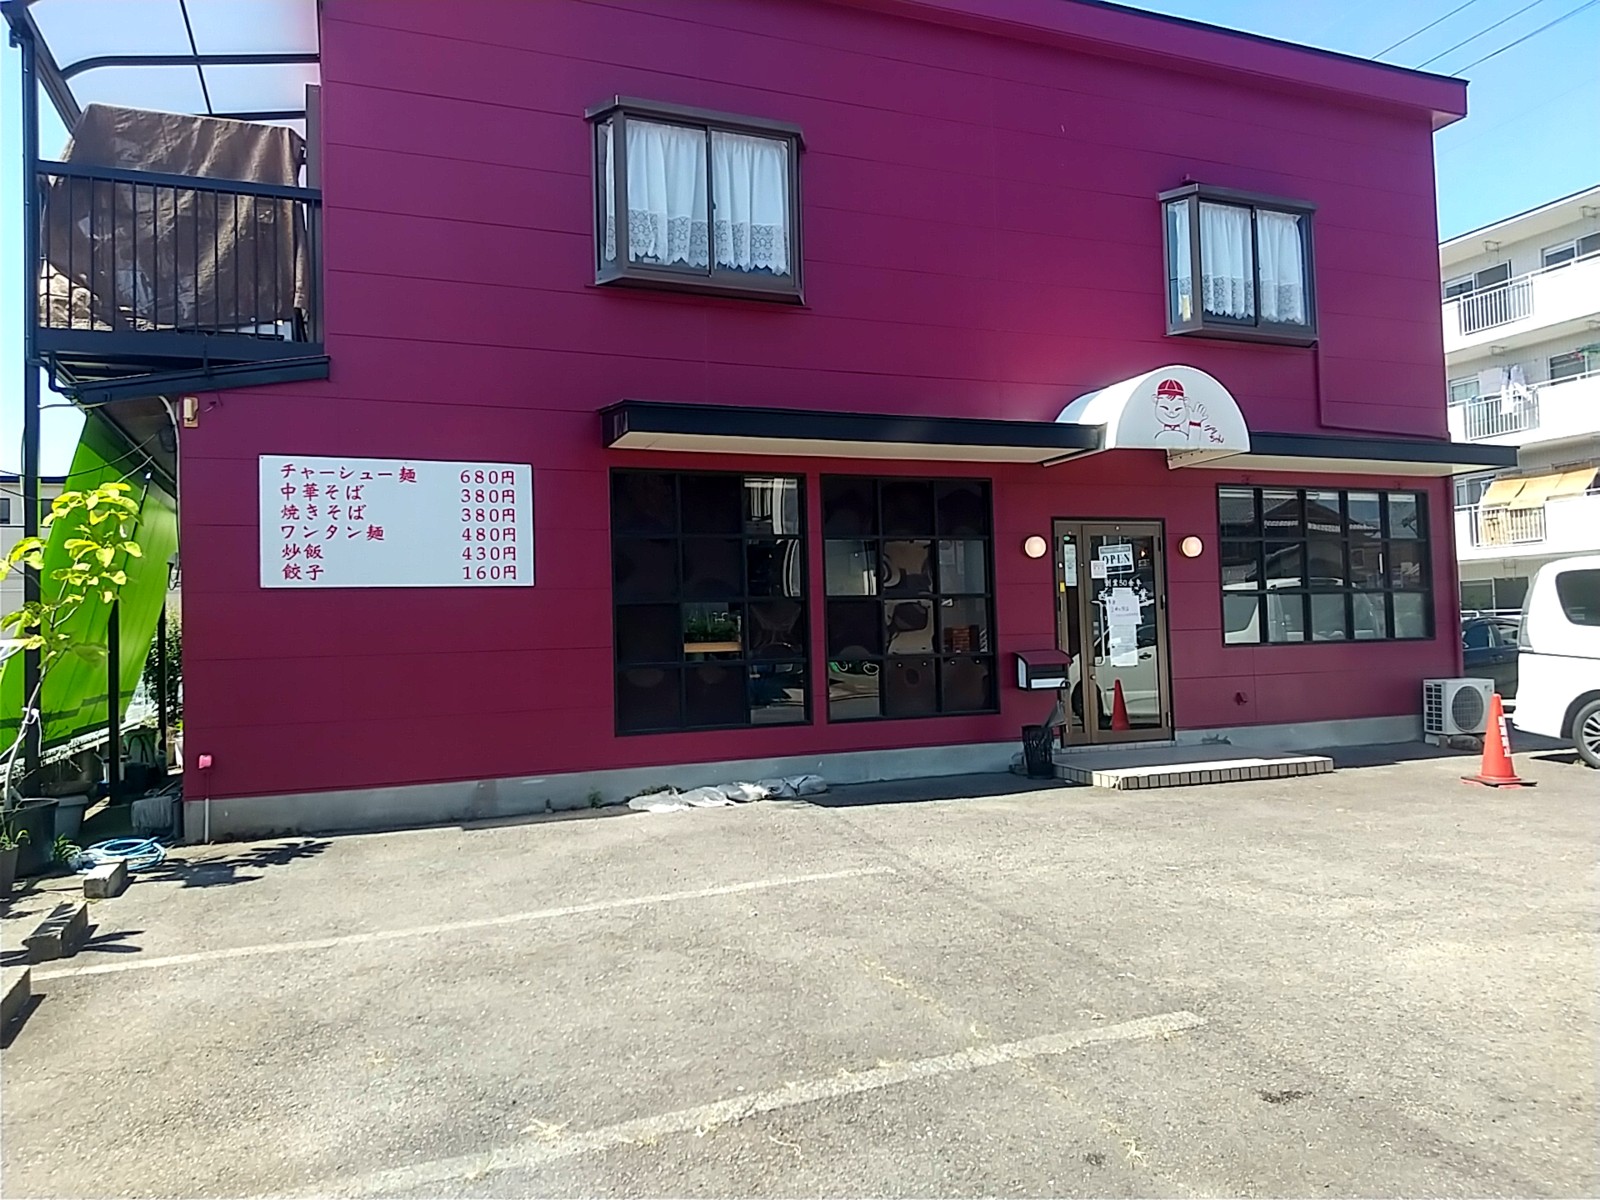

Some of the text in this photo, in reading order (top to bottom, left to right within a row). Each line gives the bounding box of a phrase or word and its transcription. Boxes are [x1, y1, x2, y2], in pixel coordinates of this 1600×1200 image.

[280, 463, 515, 486] チャーシュー麺 680円
[280, 482, 515, 504] 中華そば 380円
[280, 504, 516, 523] 焼きそば 380円
[280, 524, 516, 543] ワンタン麺 480円
[282, 543, 516, 561] 炒飯 430円
[1102, 553, 1131, 565] OPEN
[282, 563, 517, 581] 餃子 160円
